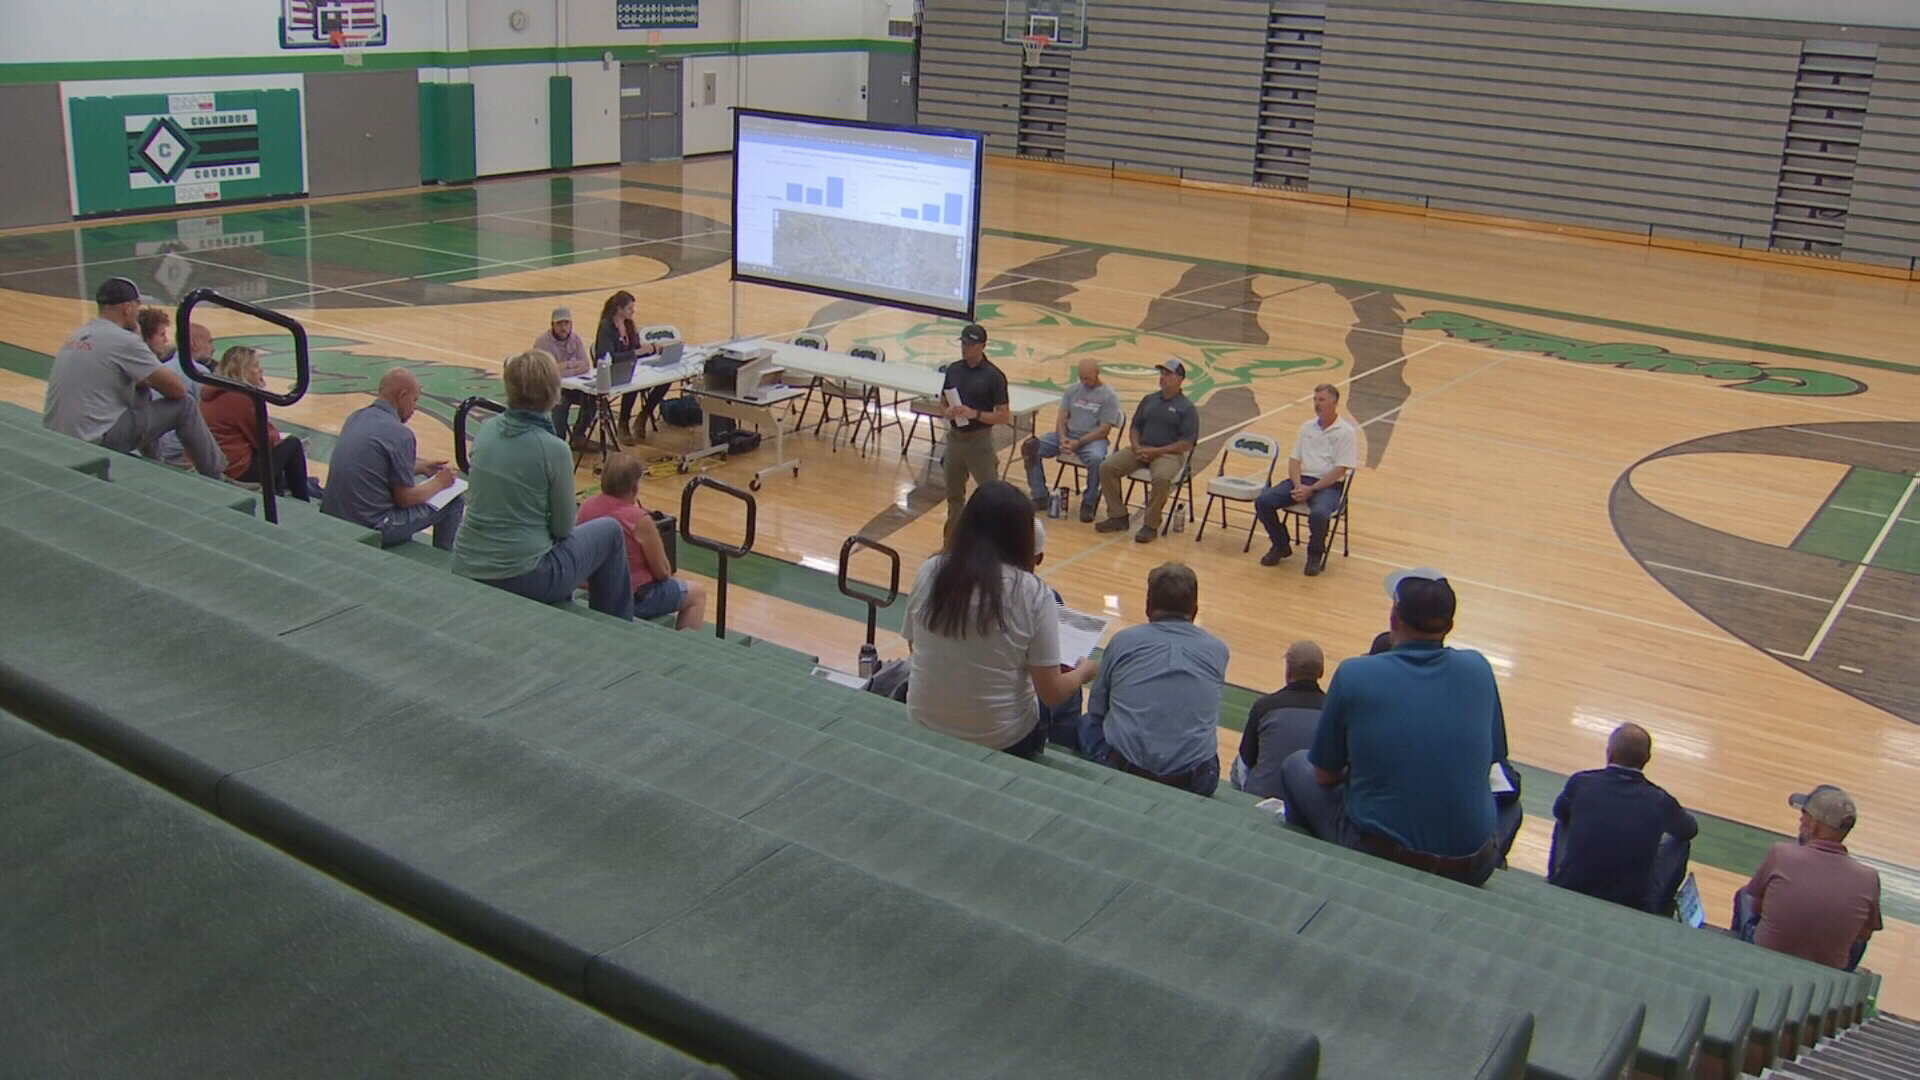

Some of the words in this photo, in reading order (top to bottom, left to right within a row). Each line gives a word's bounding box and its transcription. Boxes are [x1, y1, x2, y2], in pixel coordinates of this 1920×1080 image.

[191, 114, 248, 126] COLUMBUS
[158, 143, 172, 158] C
[194, 166, 252, 179] COUGARS
